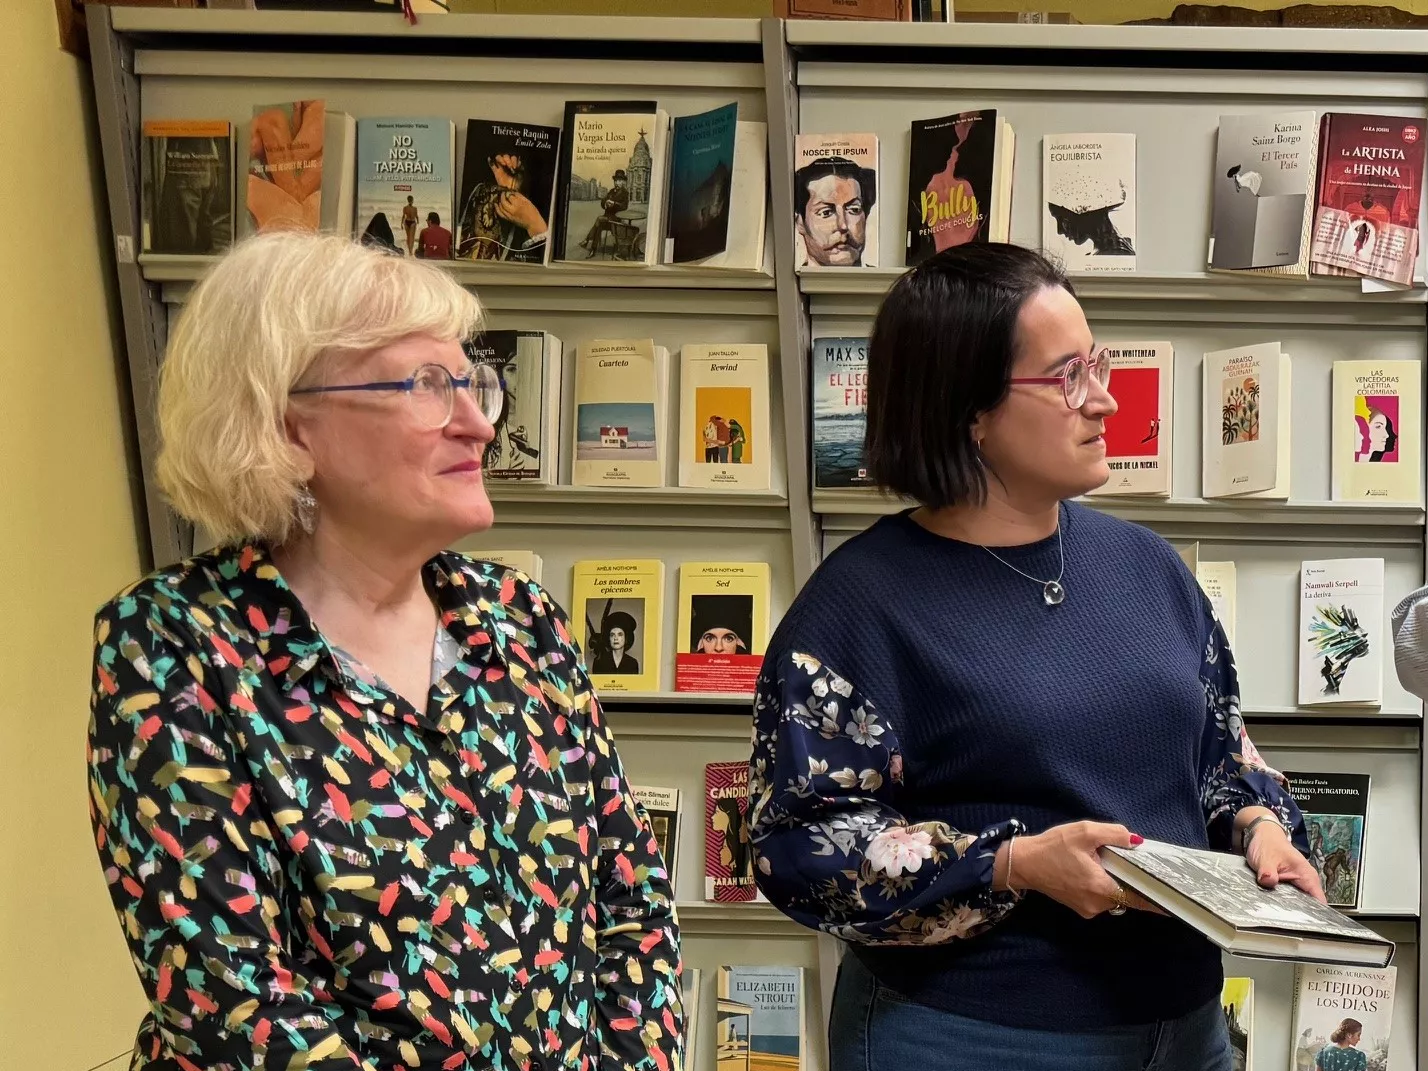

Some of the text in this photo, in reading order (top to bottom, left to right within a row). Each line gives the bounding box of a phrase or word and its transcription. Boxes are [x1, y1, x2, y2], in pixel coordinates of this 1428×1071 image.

[578, 121, 603, 131] Mario
[1274, 123, 1302, 133] Karina
[492, 125, 549, 142] Thérèse Raquin
[578, 132, 626, 144] Vargas Llosa
[393, 135, 412, 147] NO
[515, 137, 552, 150] Émile Zola
[1252, 135, 1301, 146] Sainz Borgo
[389, 148, 417, 159] NOS
[802, 147, 868, 157] NOSCE TE IPSUM
[1050, 152, 1103, 162] EQUILIBRISTA
[1261, 151, 1299, 161] El Tercer
[1352, 146, 1405, 161] ARTISTA
[373, 160, 433, 173] TAPARÁN
[1280, 160, 1298, 170] País
[1353, 163, 1401, 178] HENNA
[921, 184, 979, 229] Bully
[918, 221, 951, 237] PENELOPE
[710, 362, 738, 373] Rewind
[593, 577, 641, 586] Los nombres
[716, 579, 730, 588] Sed
[1305, 579, 1358, 590] Namwali Serpell
[600, 586, 633, 595] epicenos
[736, 982, 795, 993] ELIZABETH
[1308, 980, 1391, 999] EL TEJIDO DE
[754, 993, 796, 1004] STROUT
[1316, 997, 1339, 1008] LOS
